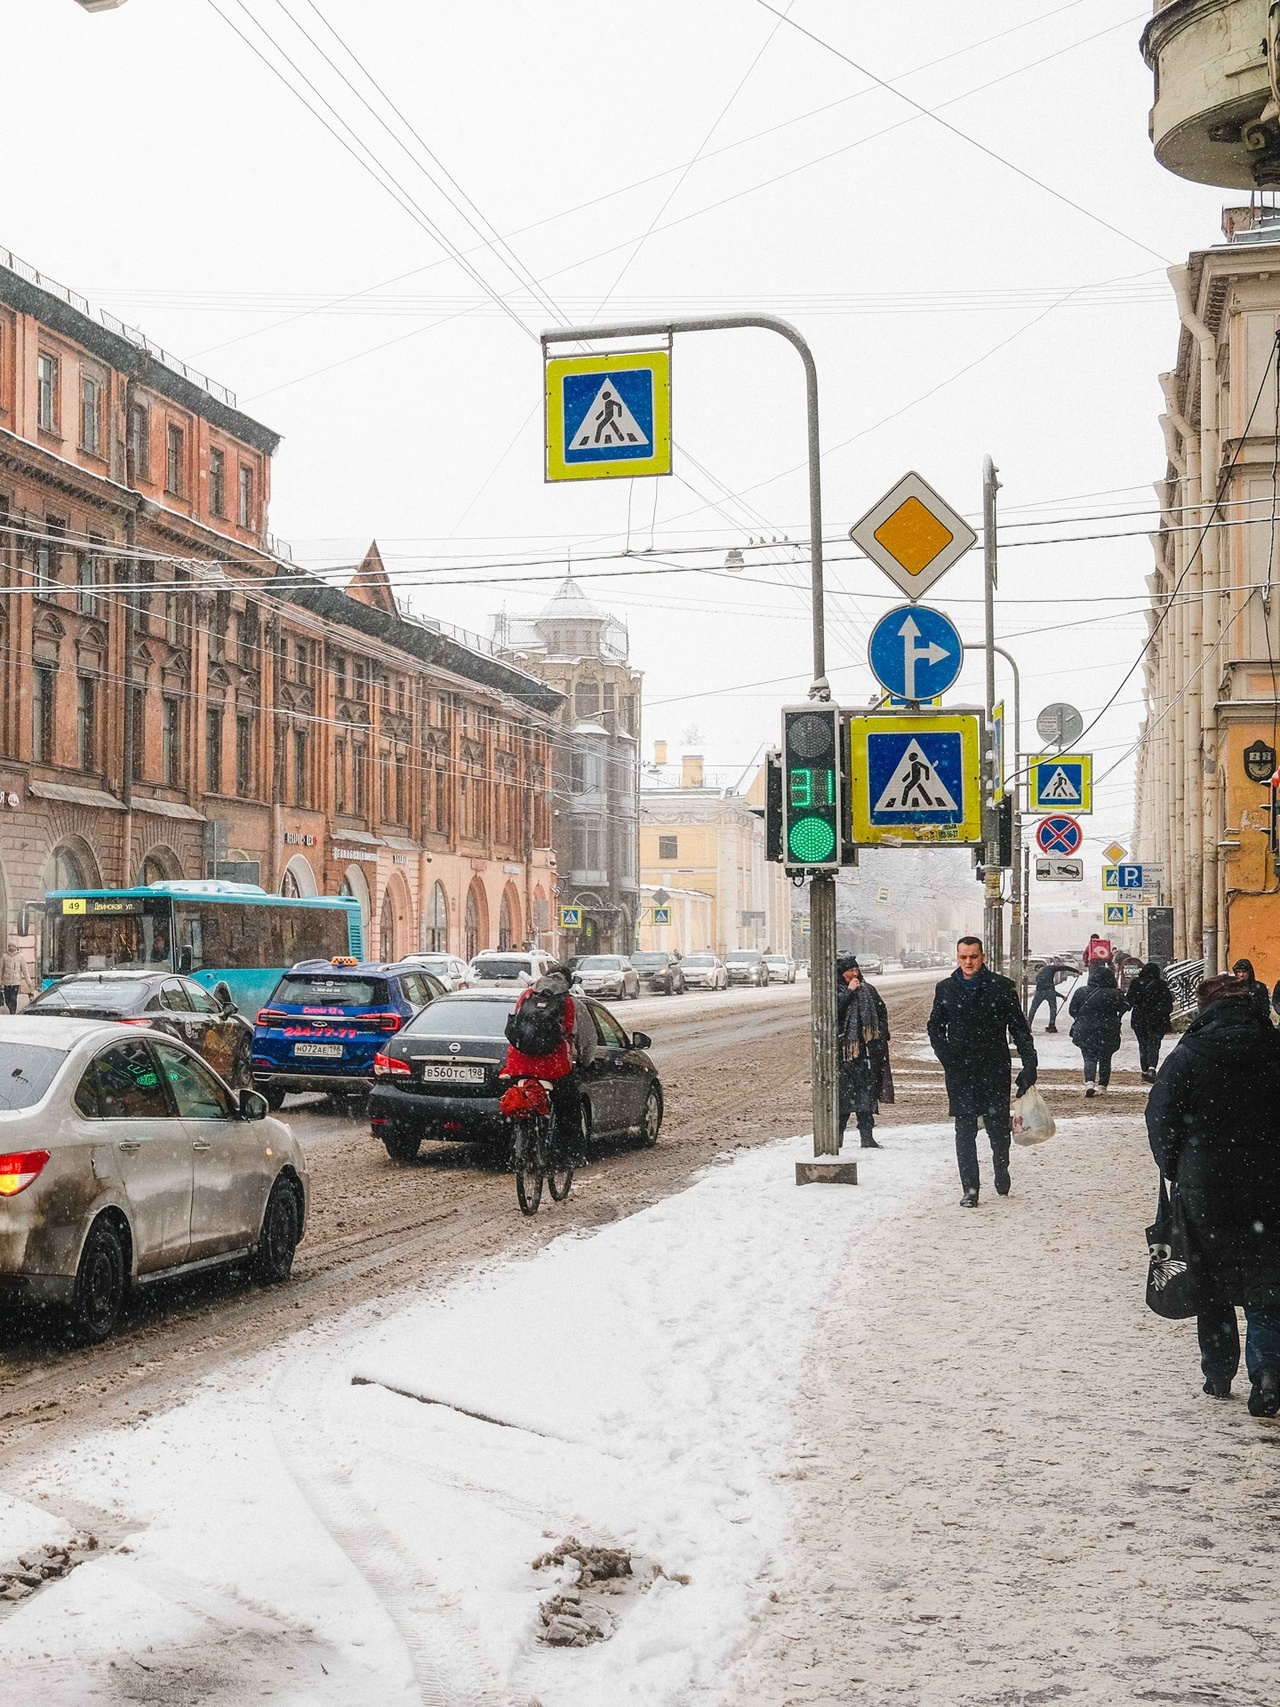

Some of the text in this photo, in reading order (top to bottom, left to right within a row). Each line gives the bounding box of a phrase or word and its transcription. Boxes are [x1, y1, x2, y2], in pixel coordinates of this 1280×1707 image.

[791, 768, 833, 807] 31
[1124, 867, 1138, 886] P
[68, 902, 80, 910] 49
[94, 902, 123, 911] Двинская
[284, 1027, 358, 1038] 244-77-77
[427, 1067, 483, 1079] В560ТС 198
